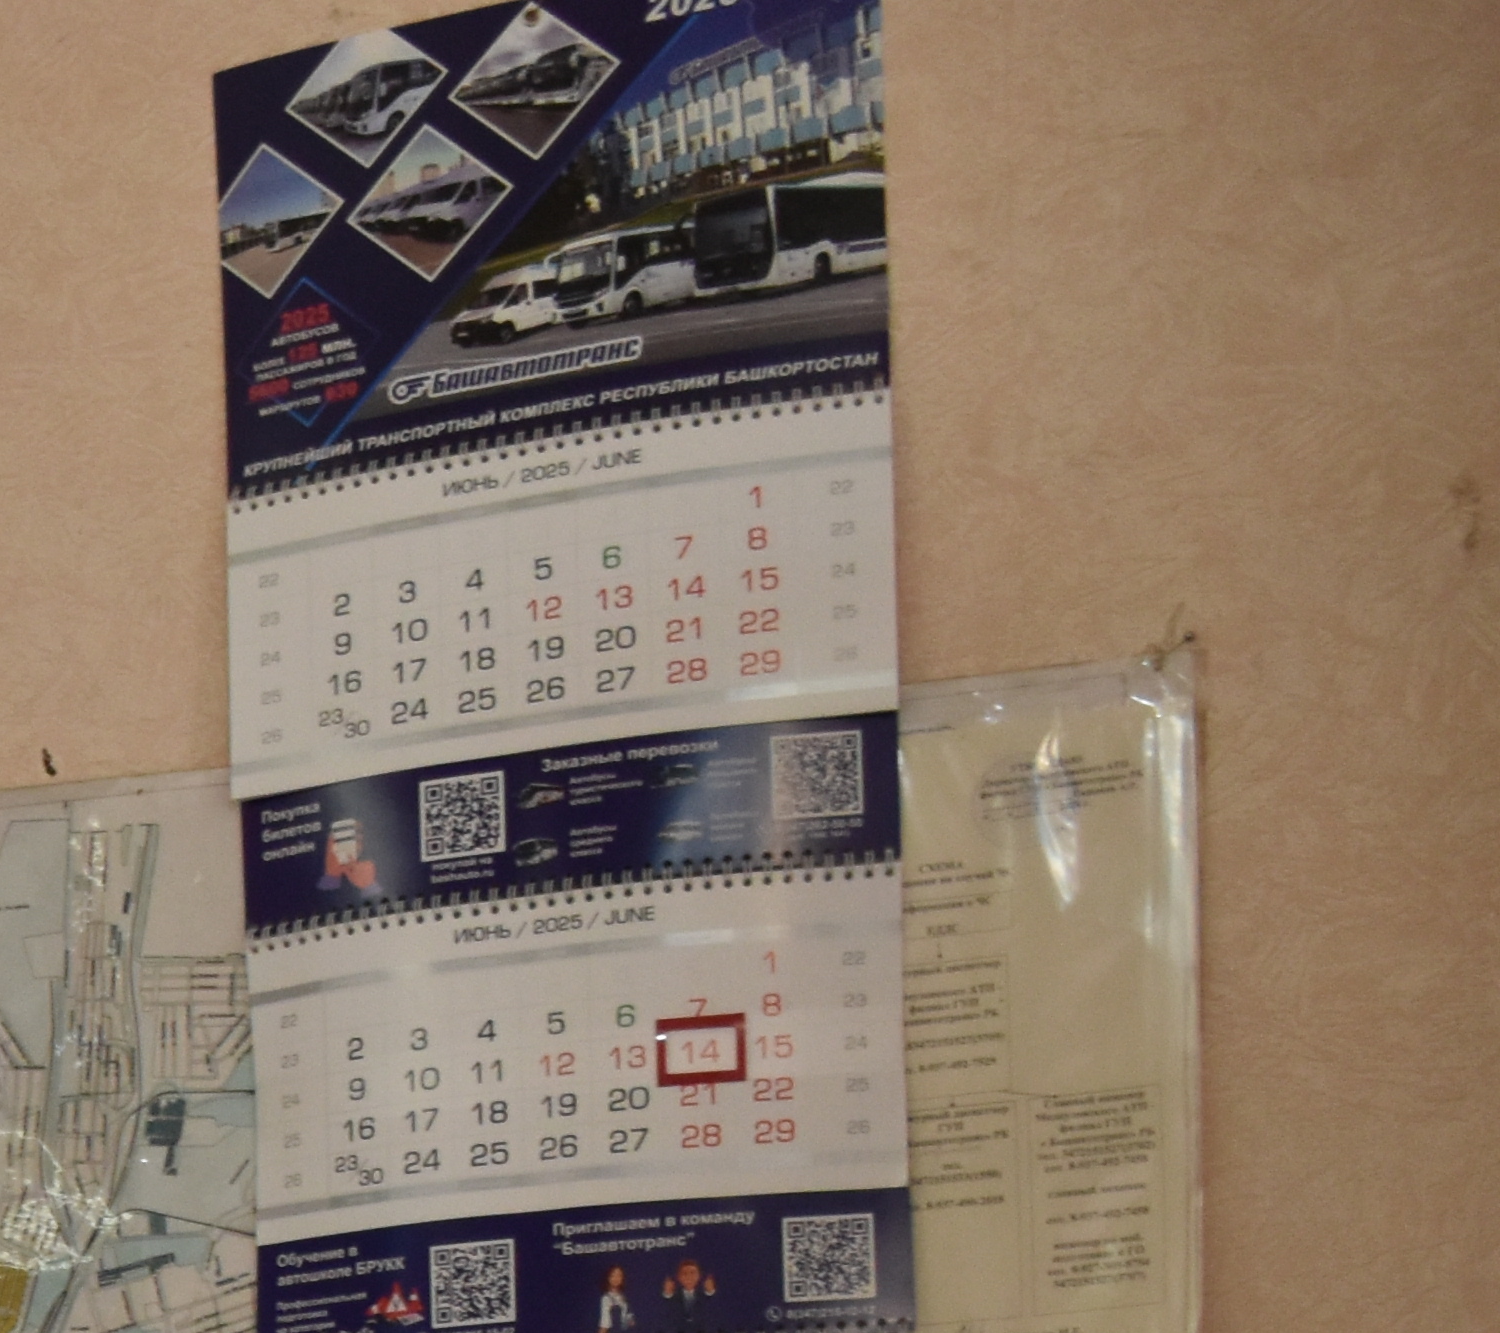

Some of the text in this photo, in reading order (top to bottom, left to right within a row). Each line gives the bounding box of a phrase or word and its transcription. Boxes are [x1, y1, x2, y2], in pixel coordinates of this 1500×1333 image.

[243, 351, 880, 478] КРУПНЕЙШИЙ ТРАНСПОРТНЫЙ КОМПЛЕКС РЕСПУБЛИКИ БАШКОРТОСТАН
[442, 448, 642, 497] ИЮНЬ 2025 JUNE
[748, 484, 763, 509] 1
[333, 525, 769, 618] 2 3 4 5 6 7 8
[333, 565, 781, 656] 9 10 11 12 13 14 15
[327, 607, 781, 696] 16 17 18 19 20 21 22
[390, 696, 429, 726] 24
[457, 686, 497, 715] 25
[526, 675, 566, 704] 26
[595, 664, 636, 694] 27
[666, 657, 709, 685] 28
[739, 648, 783, 677] 29
[541, 738, 719, 773] Заказные перевозки
[261, 801, 321, 826] Покупка
[261, 821, 322, 844] билетов
[261, 840, 316, 862] онлайн
[453, 905, 657, 945] ИЮНЬ 2025 JUNE
[762, 949, 778, 975] 1
[347, 992, 783, 1062] 2 3 4 5 6 7 8
[348, 1034, 794, 1102] 9 10 11 12 13 14 15
[342, 1076, 795, 1143] 16 17 18 19 20 21 22
[403, 1148, 442, 1175] 24
[469, 1140, 510, 1168] 25
[539, 1133, 579, 1162] 26
[608, 1126, 650, 1154] 27
[681, 1122, 723, 1150] 28
[754, 1117, 797, 1145] 29
[552, 1211, 755, 1238] Приглашаем в команду
[276, 1246, 359, 1269] Обучение в
[276, 1256, 406, 1287] автошколе БРУКК
